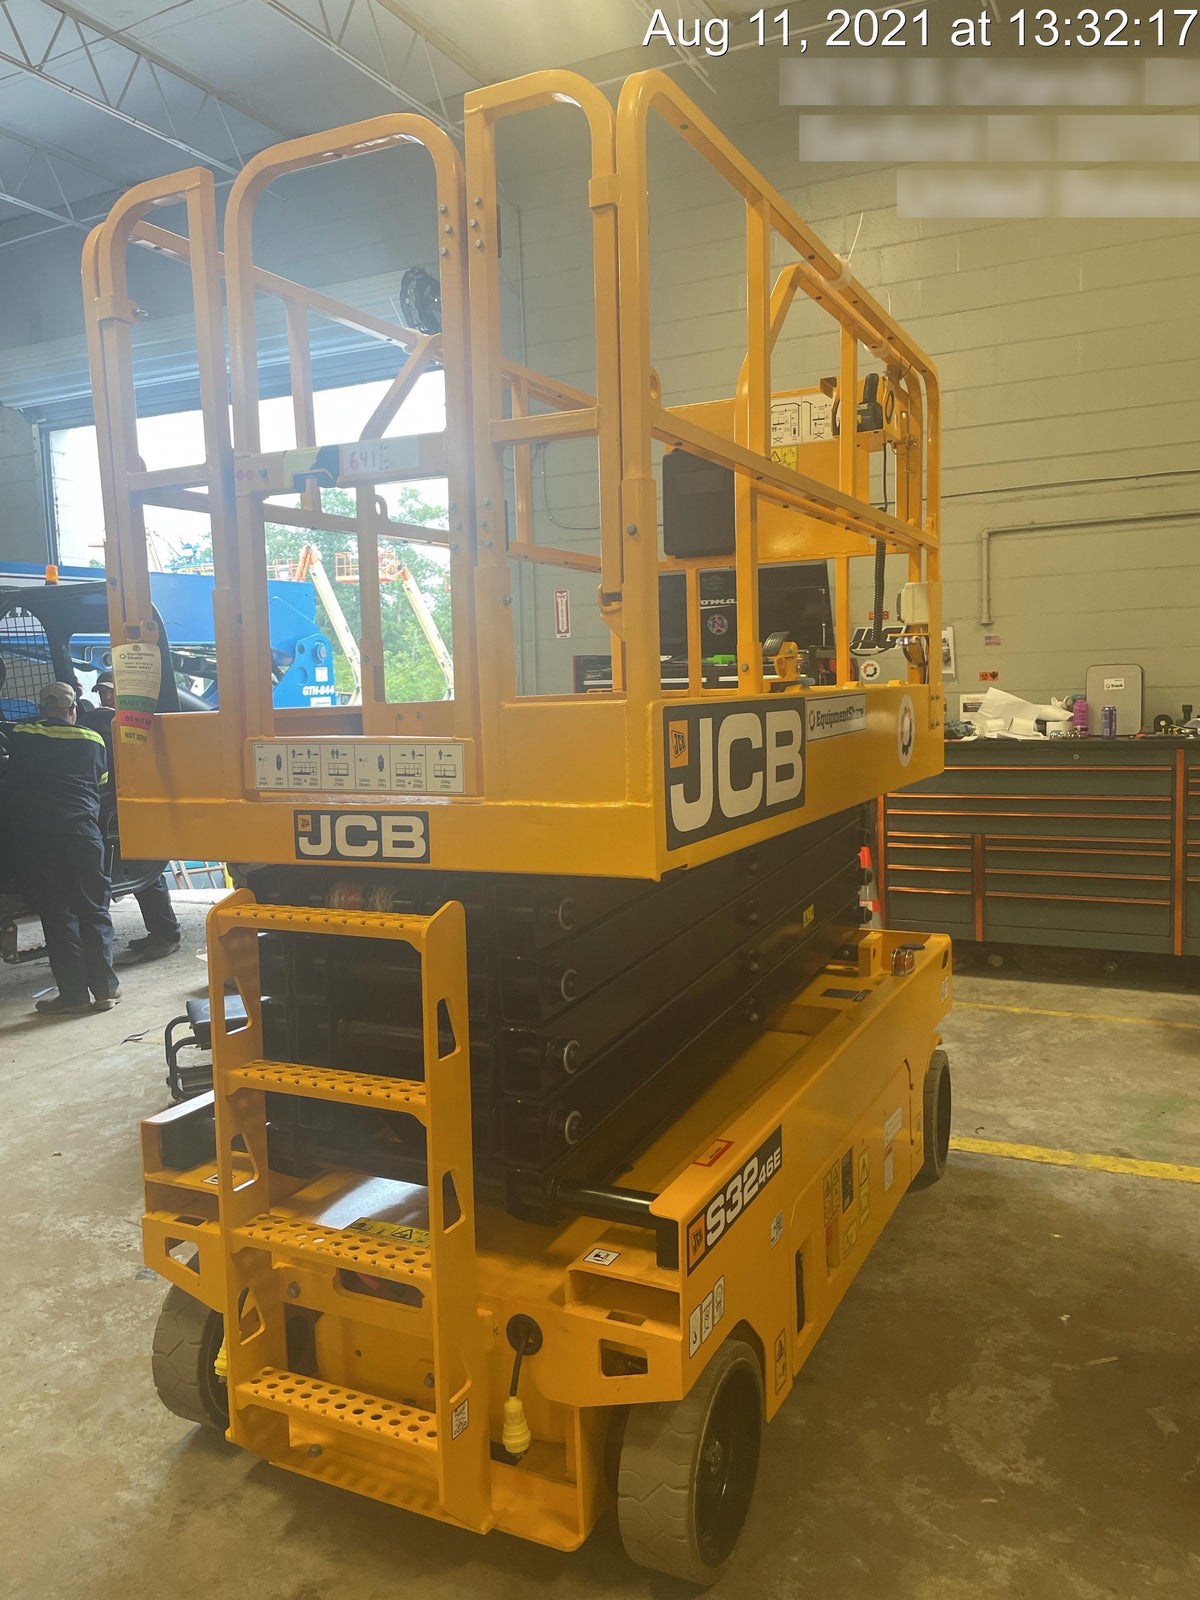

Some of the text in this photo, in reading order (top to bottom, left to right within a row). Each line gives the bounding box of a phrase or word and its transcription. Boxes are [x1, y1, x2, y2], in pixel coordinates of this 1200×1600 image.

[816, 705, 864, 729] EquipmentShare
[670, 709, 803, 832] JCB
[298, 814, 427, 858] JCB
